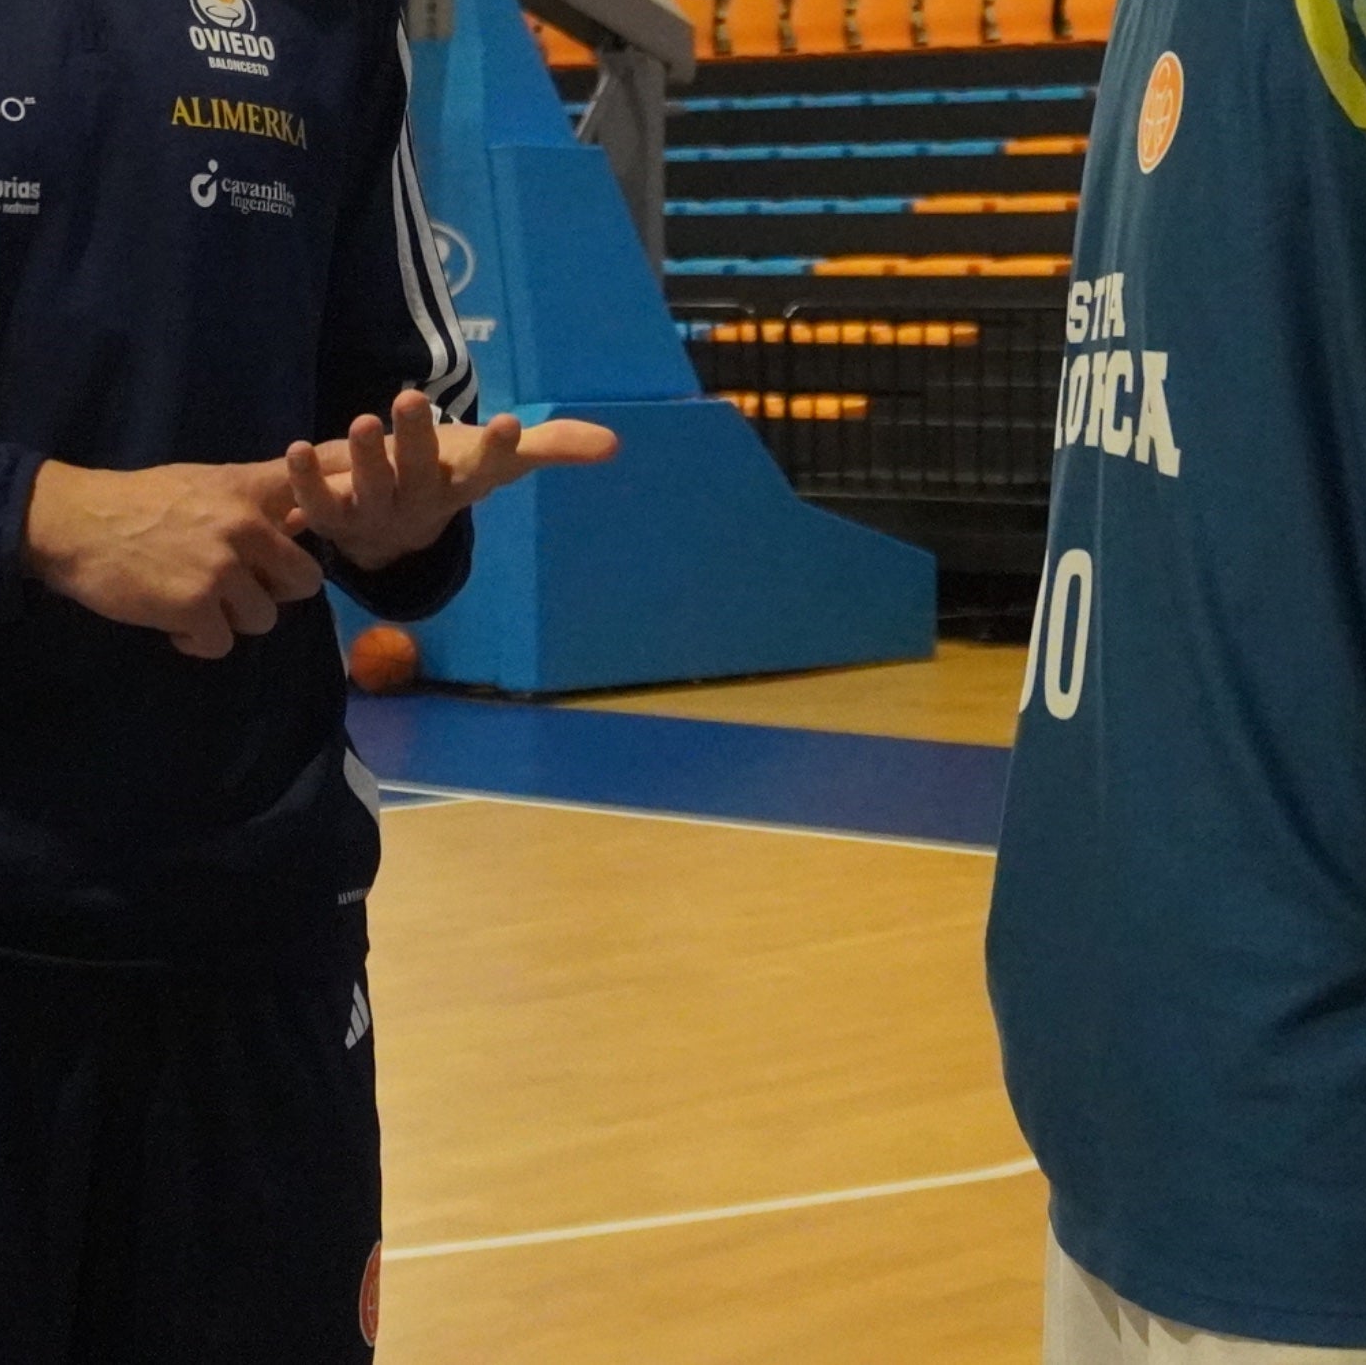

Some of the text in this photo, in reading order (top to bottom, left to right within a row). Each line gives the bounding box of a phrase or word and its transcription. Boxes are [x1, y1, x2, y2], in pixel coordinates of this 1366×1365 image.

[189, 25, 276, 61] OVIEDO
[208, 56, 270, 77] BALONCESTO
[171, 95, 308, 151] ALIMERKA
